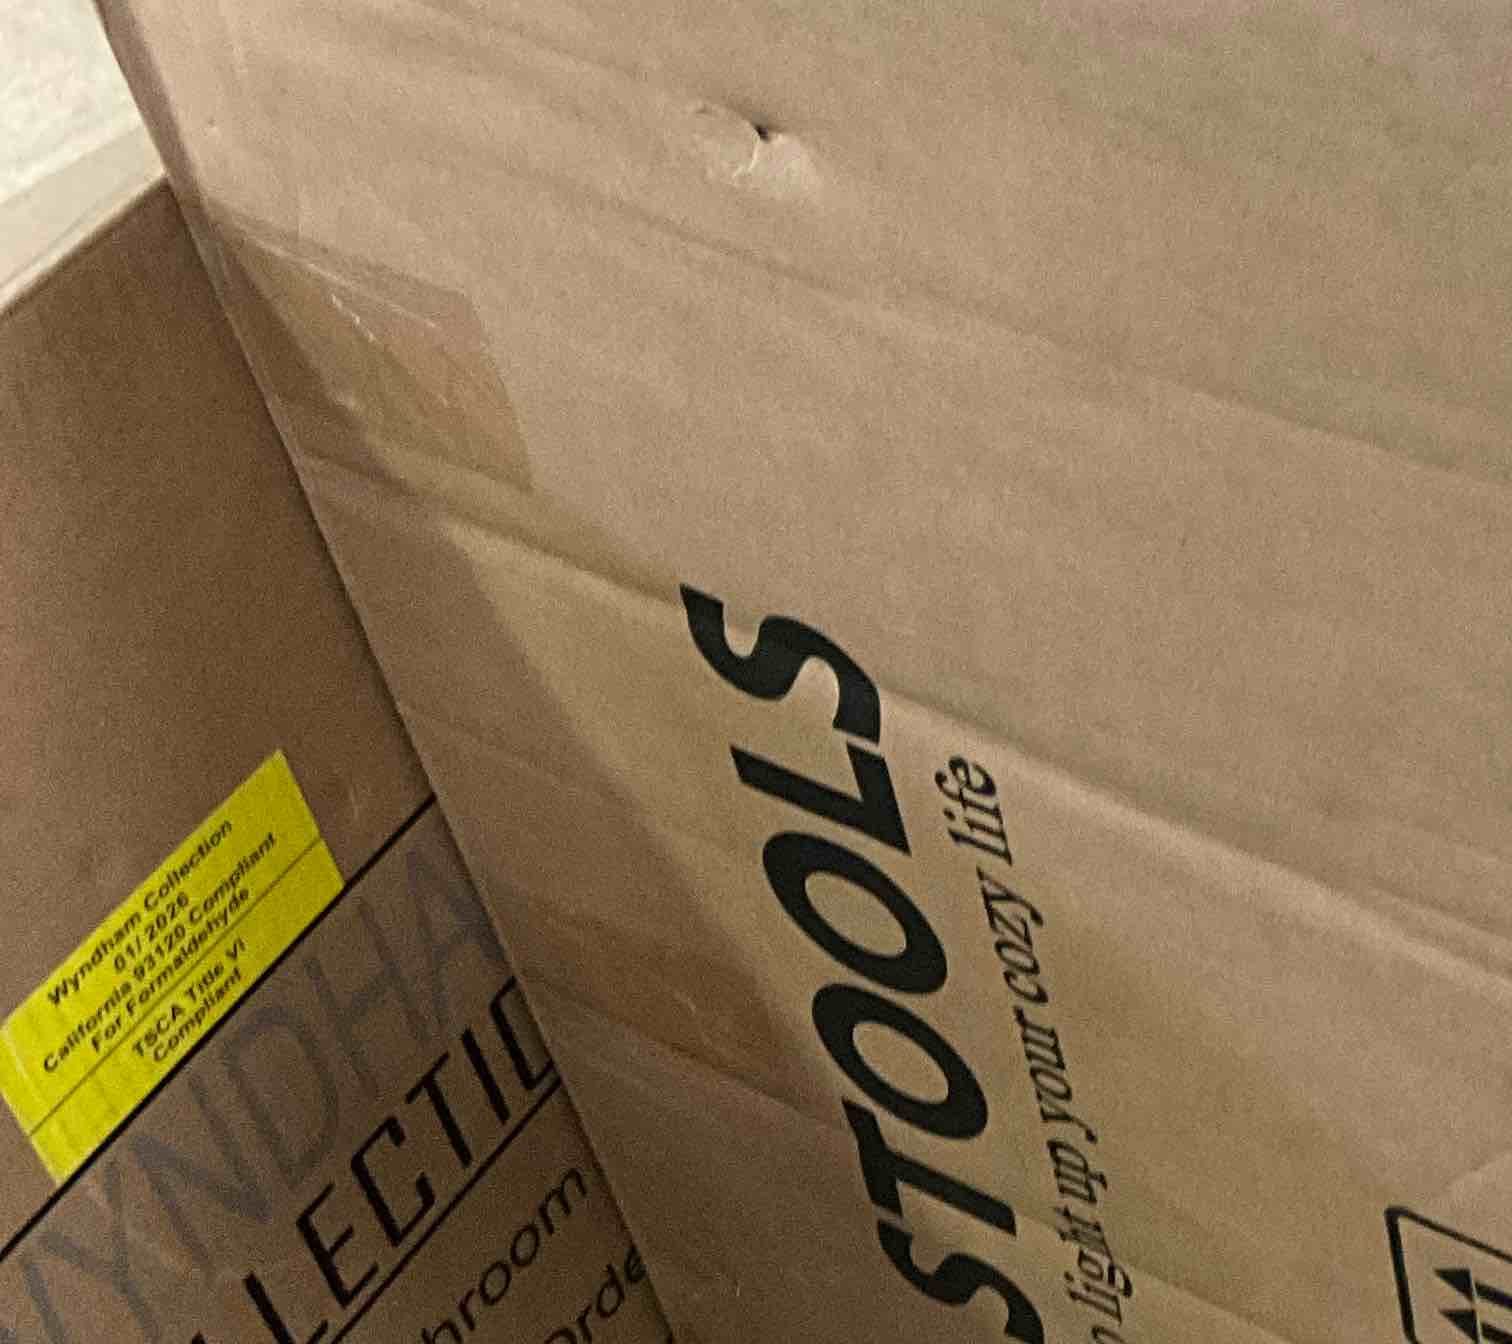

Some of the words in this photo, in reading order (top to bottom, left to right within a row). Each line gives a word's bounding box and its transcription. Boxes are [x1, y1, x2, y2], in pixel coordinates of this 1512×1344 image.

[935, 756, 1012, 866] life
[43, 981, 132, 1072] California
[133, 923, 186, 982] 93120
[189, 831, 276, 923] Compliant
[48, 911, 141, 1006] Wyndham
[144, 819, 233, 911] Collection
[91, 1015, 121, 1053] For
[126, 888, 249, 1014] Formaldehyde
[976, 863, 1048, 1005] cozy
[133, 1004, 186, 1057] TSCA
[185, 960, 224, 1002] Title
[153, 966, 241, 1062] Compliant
[1013, 1005, 1098, 1144] your
[1047, 1139, 1108, 1204] up
[1054, 1205, 1132, 1327] light
